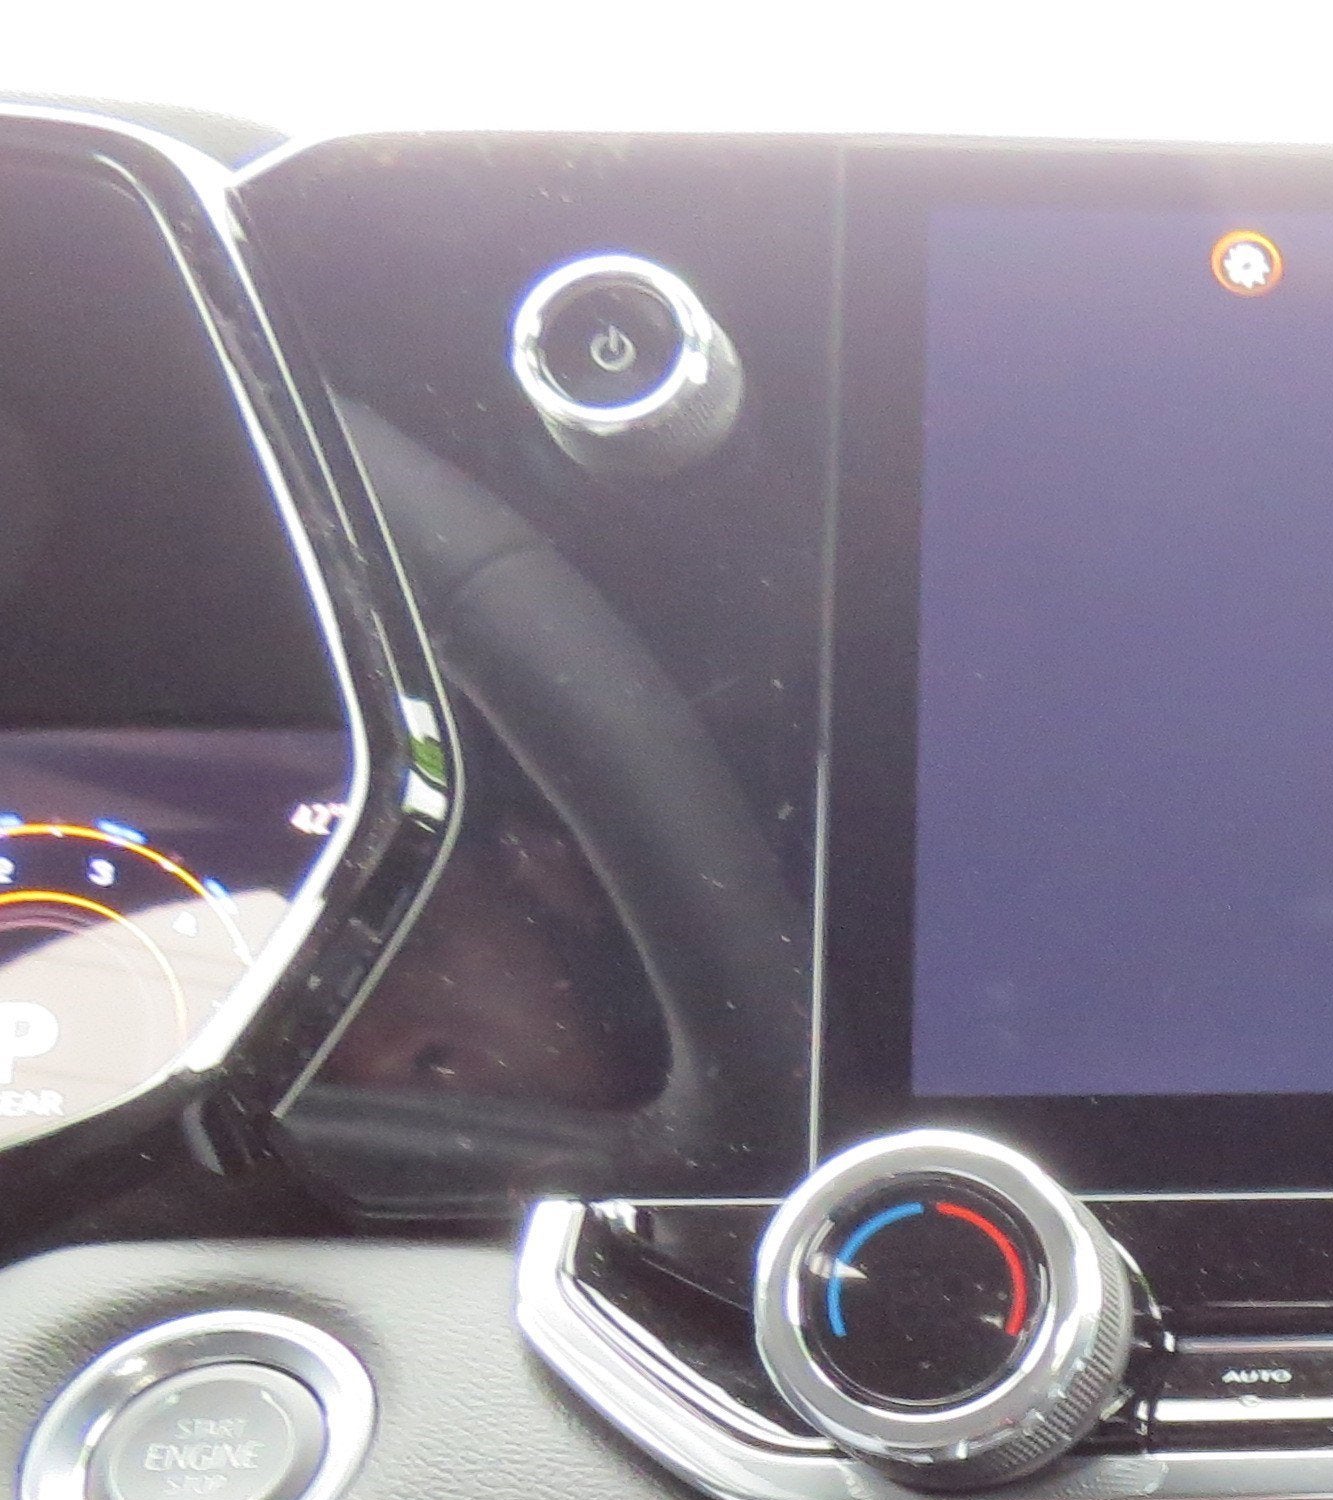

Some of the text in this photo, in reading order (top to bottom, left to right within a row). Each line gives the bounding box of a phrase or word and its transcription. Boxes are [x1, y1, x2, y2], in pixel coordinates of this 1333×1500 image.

[87, 858, 116, 888] 3
[1221, 1368, 1293, 1384] AUTO
[143, 1440, 267, 1472] ENGINE
